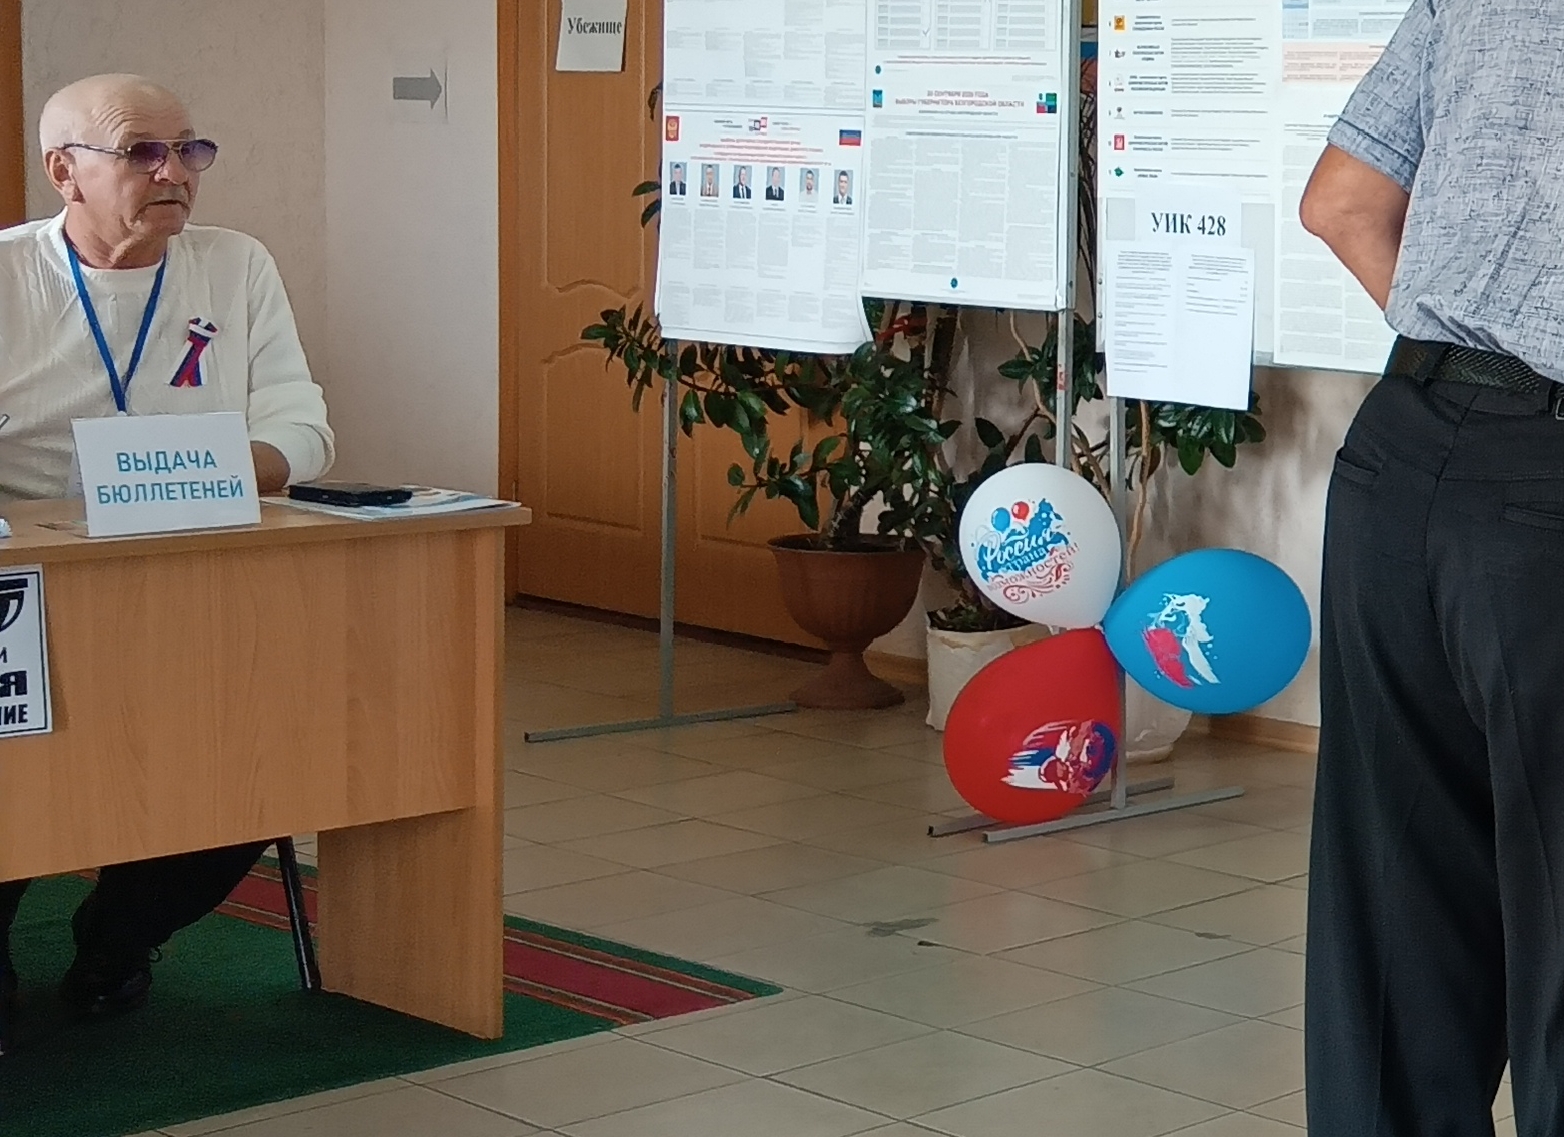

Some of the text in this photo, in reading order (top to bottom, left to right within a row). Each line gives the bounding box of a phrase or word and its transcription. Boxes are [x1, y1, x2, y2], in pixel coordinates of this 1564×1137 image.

[567, 17, 622, 35] Убежище
[1151, 212, 1226, 236] УИК 428
[116, 449, 218, 474] ВЫДАЧА
[97, 475, 244, 505] БЮЛЛЕТЕНЕЙ
